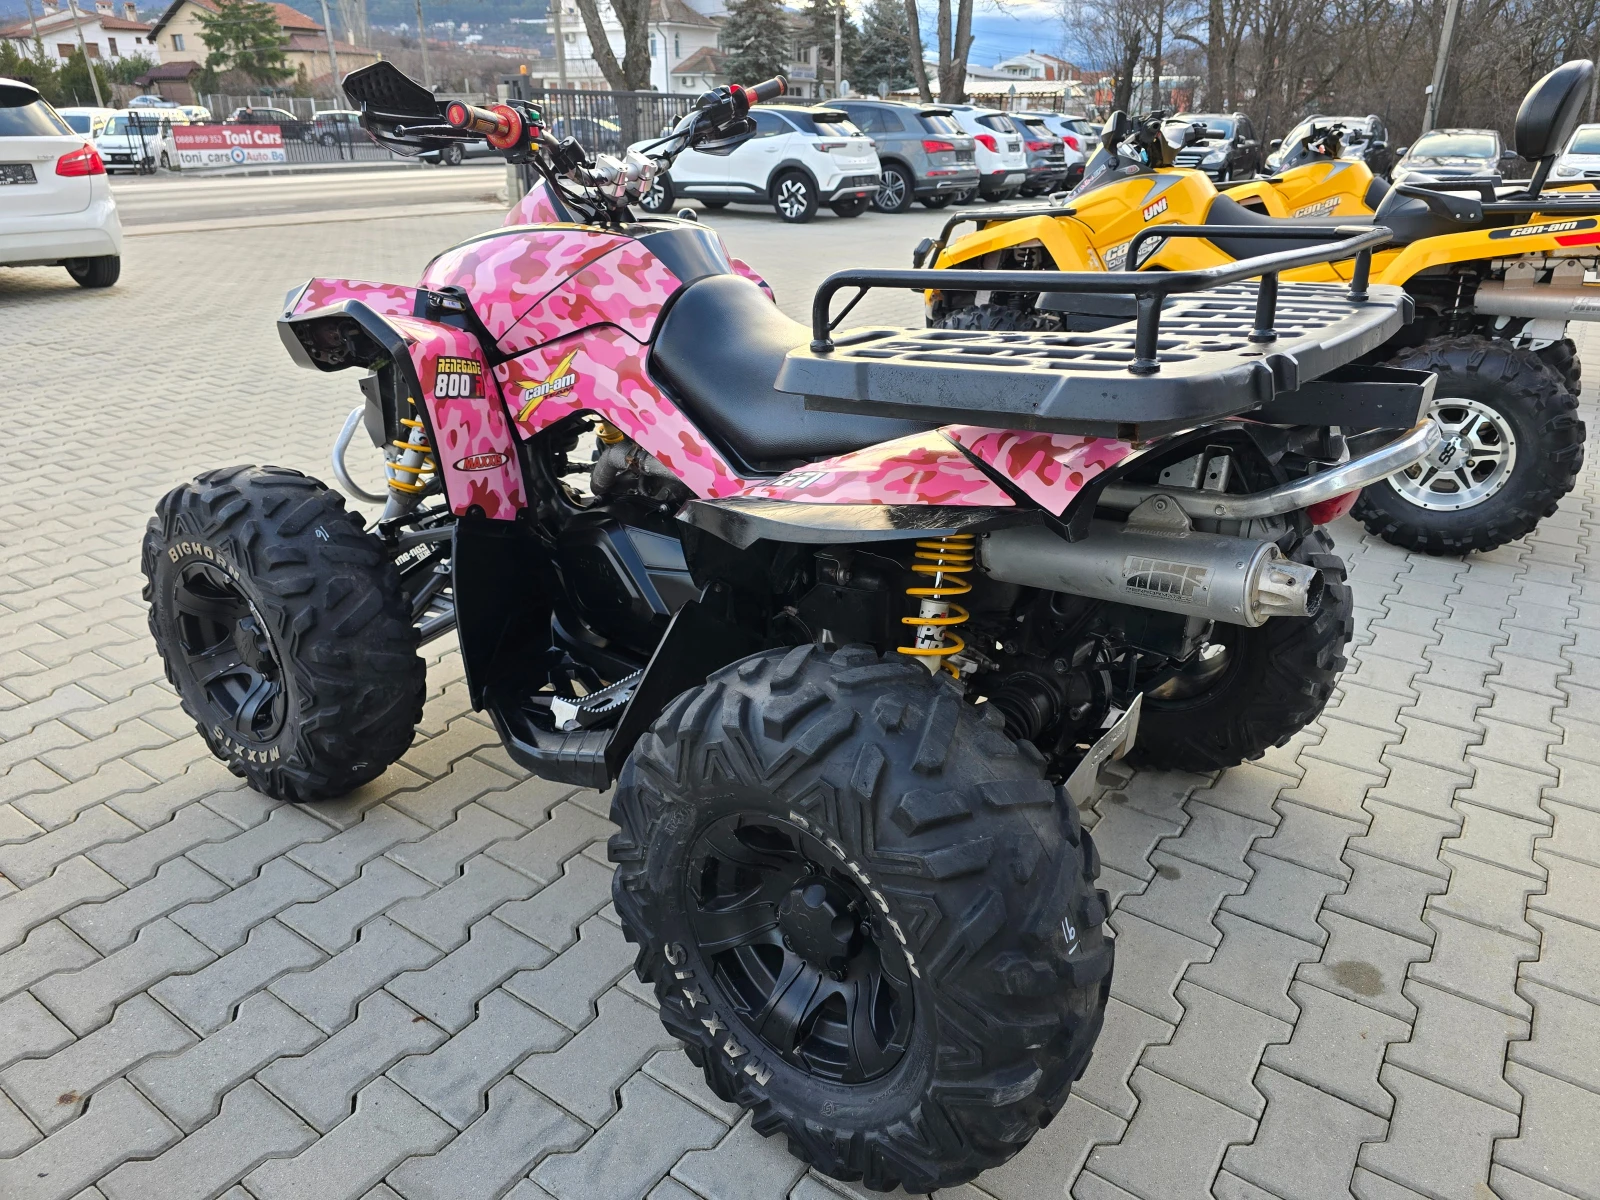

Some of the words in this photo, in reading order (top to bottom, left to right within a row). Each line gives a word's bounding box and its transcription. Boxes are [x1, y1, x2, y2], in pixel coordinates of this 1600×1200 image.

[175, 135, 195, 144] 0888
[195, 135, 209, 144] 899
[209, 134, 222, 144] 352
[222, 129, 253, 145] Toni
[253, 129, 282, 145] Cars
[179, 151, 231, 166] toni_cars
[1144, 197, 1168, 221] UNI
[1510, 221, 1578, 237] can-am
[437, 358, 482, 375] RENEGADE
[435, 373, 471, 397] 800
[525, 373, 576, 401] can-am
[463, 455, 503, 470] MAXXIS
[167, 541, 240, 582] BIGHORN
[212, 724, 281, 764] MAXXIS
[789, 809, 921, 979] BIGHORN
[664, 941, 775, 1087] MAXXIS
